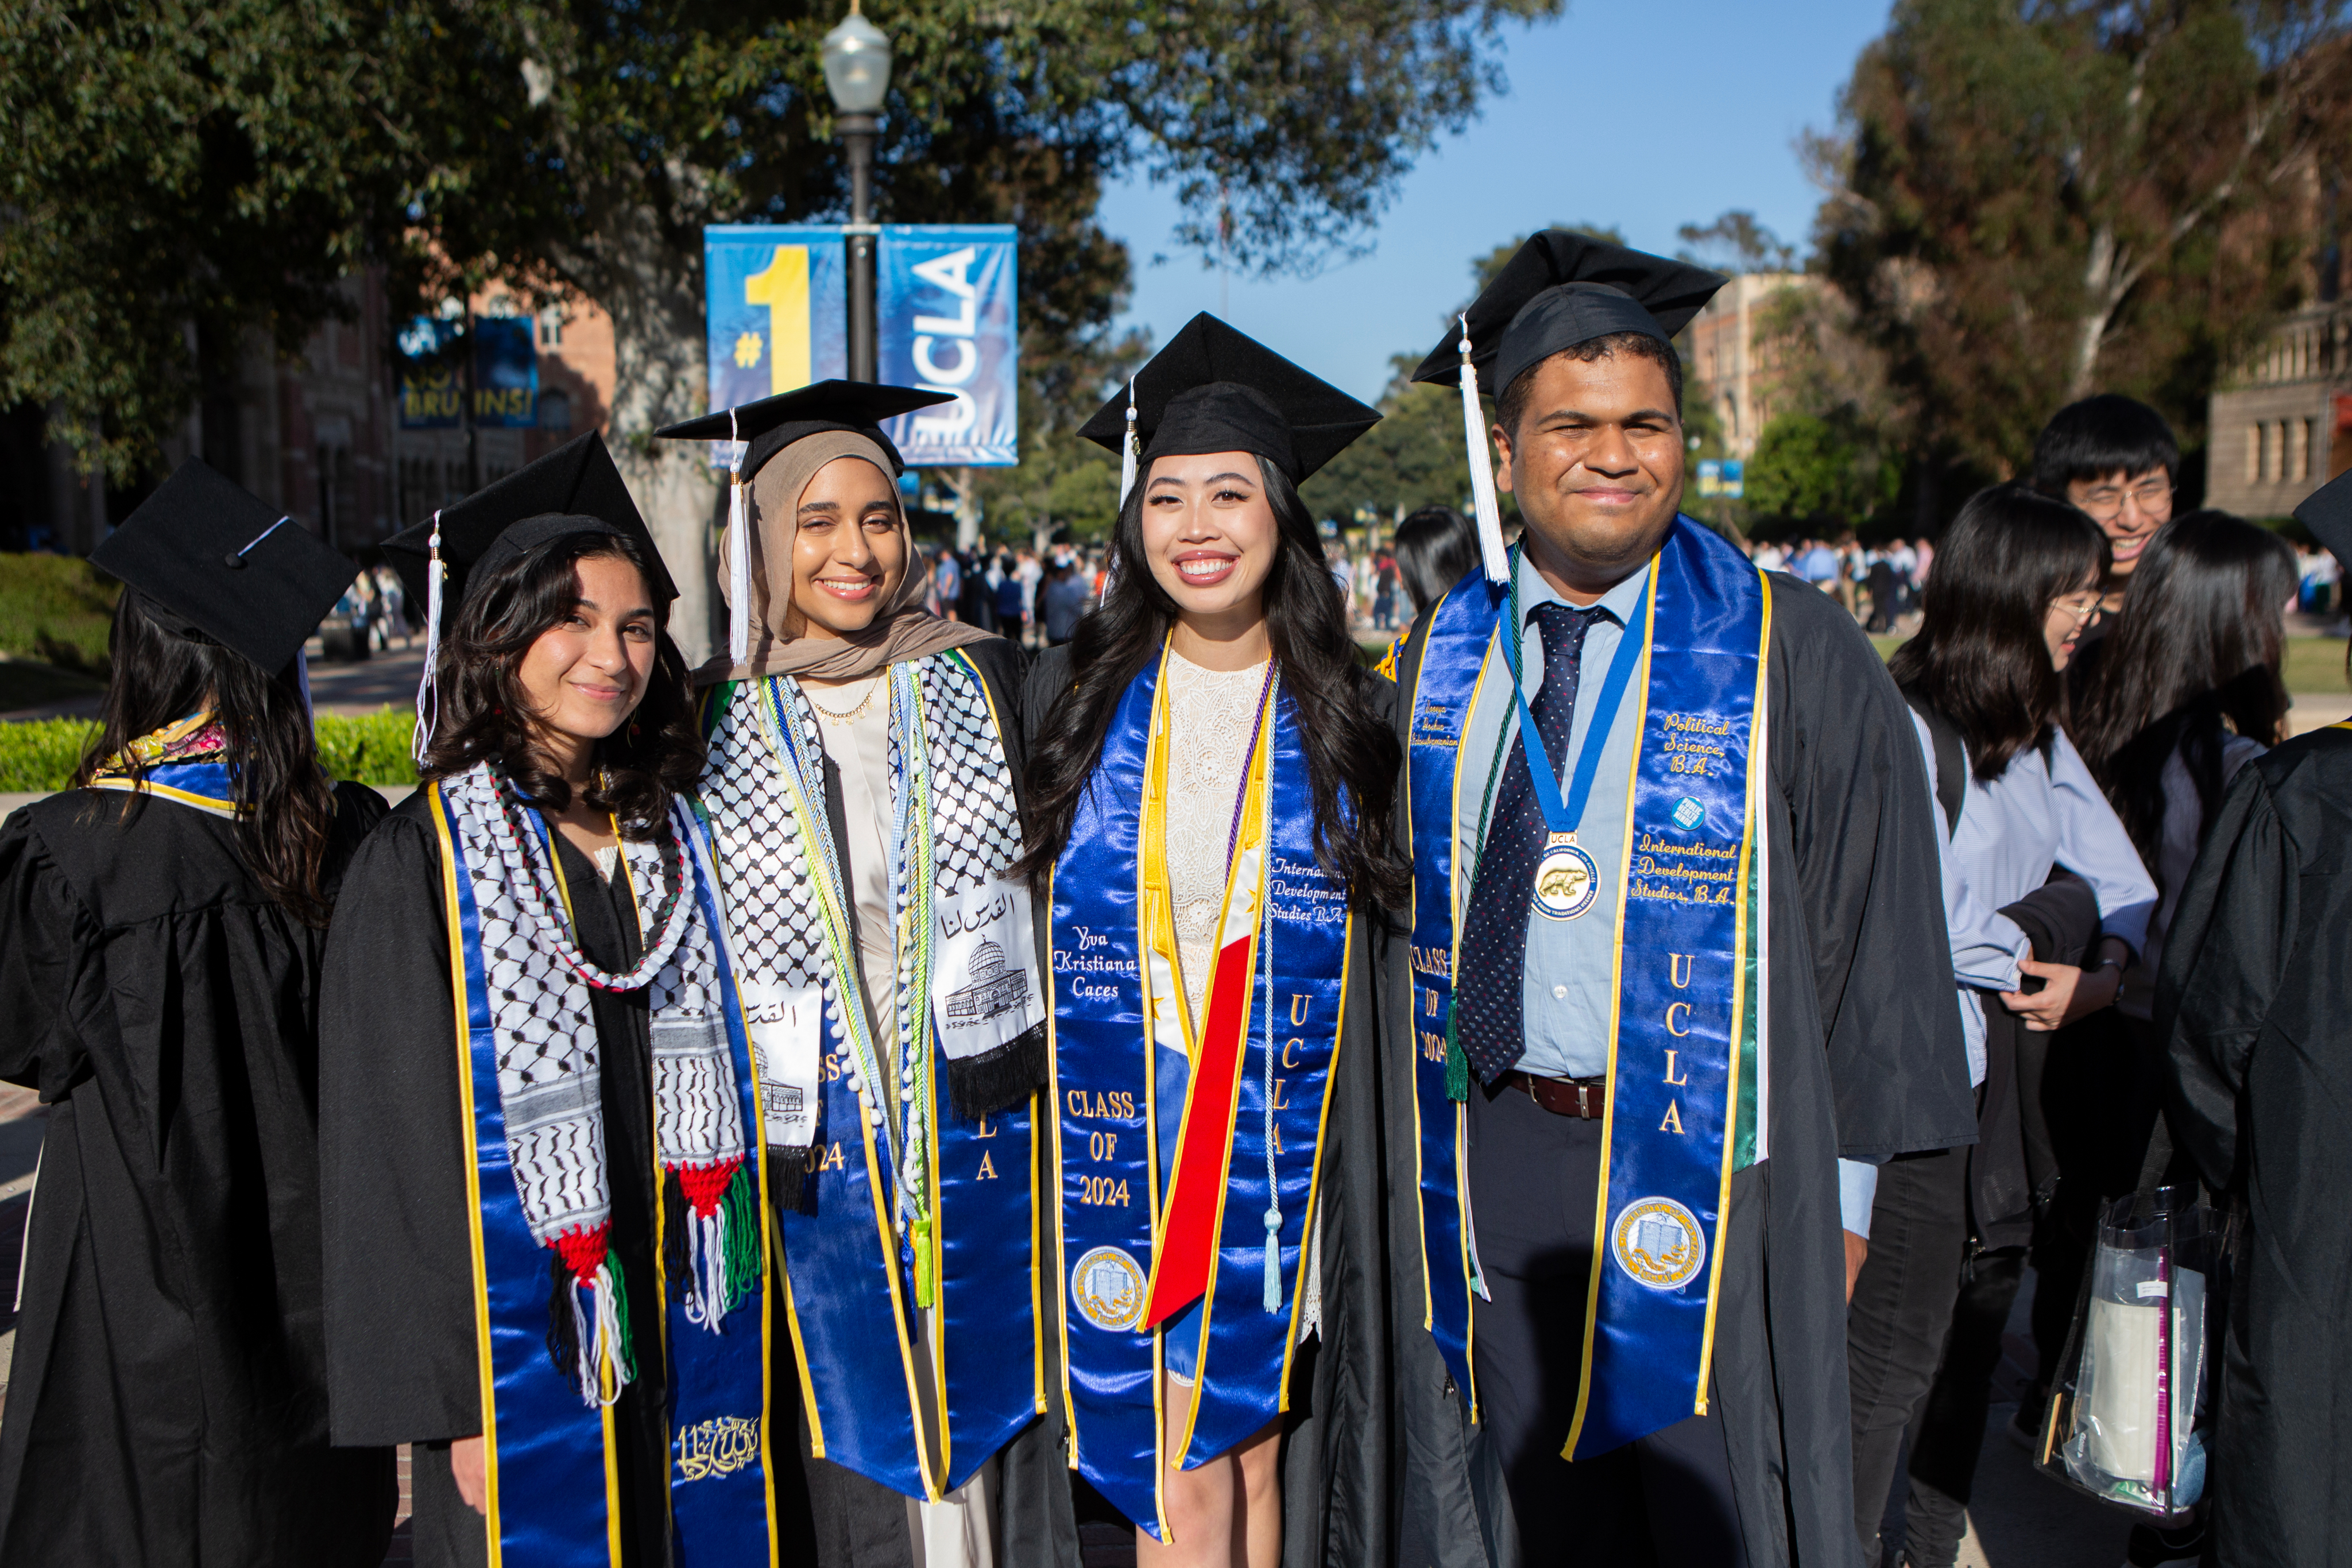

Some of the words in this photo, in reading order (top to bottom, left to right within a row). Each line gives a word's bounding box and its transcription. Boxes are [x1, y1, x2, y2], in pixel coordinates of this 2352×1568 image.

[734, 244, 811, 396] #1
[911, 246, 977, 436] UCLA
[1664, 714, 1730, 735] Political
[1664, 733, 1725, 758] Science,
[1671, 755, 1714, 776] B.A.
[1673, 810, 1693, 827] MINOR
[1677, 804, 1699, 822] HEALTH
[1681, 797, 1703, 815] PUBLIC
[1639, 834, 1736, 858] International
[1580, 854, 1588, 862] LOS
[1587, 862, 1595, 883] ANGELES
[1638, 857, 1734, 884] Development
[1271, 880, 1347, 904] Development
[1537, 902, 1551, 913] BRUIN
[1552, 906, 1581, 916] TRADITIONS
[1580, 891, 1595, 908] KEEPER
[1631, 879, 1689, 903] Studies,
[1694, 885, 1735, 905] B.A.
[941, 909, 962, 940] لنا
[964, 892, 1015, 932] القدس
[1270, 903, 1312, 921] Studies
[1313, 906, 1343, 923] B.A.
[1072, 926, 1108, 950] Yva
[1054, 951, 1136, 971] Kristiana
[1410, 944, 1447, 976] CLASS
[1073, 977, 1119, 997] Caces
[1426, 988, 1439, 1017] OF
[1421, 1031, 1448, 1066] 2024
[1659, 953, 1695, 1135] UCLA
[1273, 994, 1313, 1155] UCLA
[1067, 1090, 1135, 1119] CLASS
[804, 1141, 844, 1174] 024
[1090, 1131, 1117, 1162] OF
[1080, 1175, 1130, 1207] 2024
[1620, 1205, 1664, 1238] UNIVERSITY
[1669, 1209, 1681, 1218] OF
[1681, 1221, 1699, 1275] CALIFORNIA
